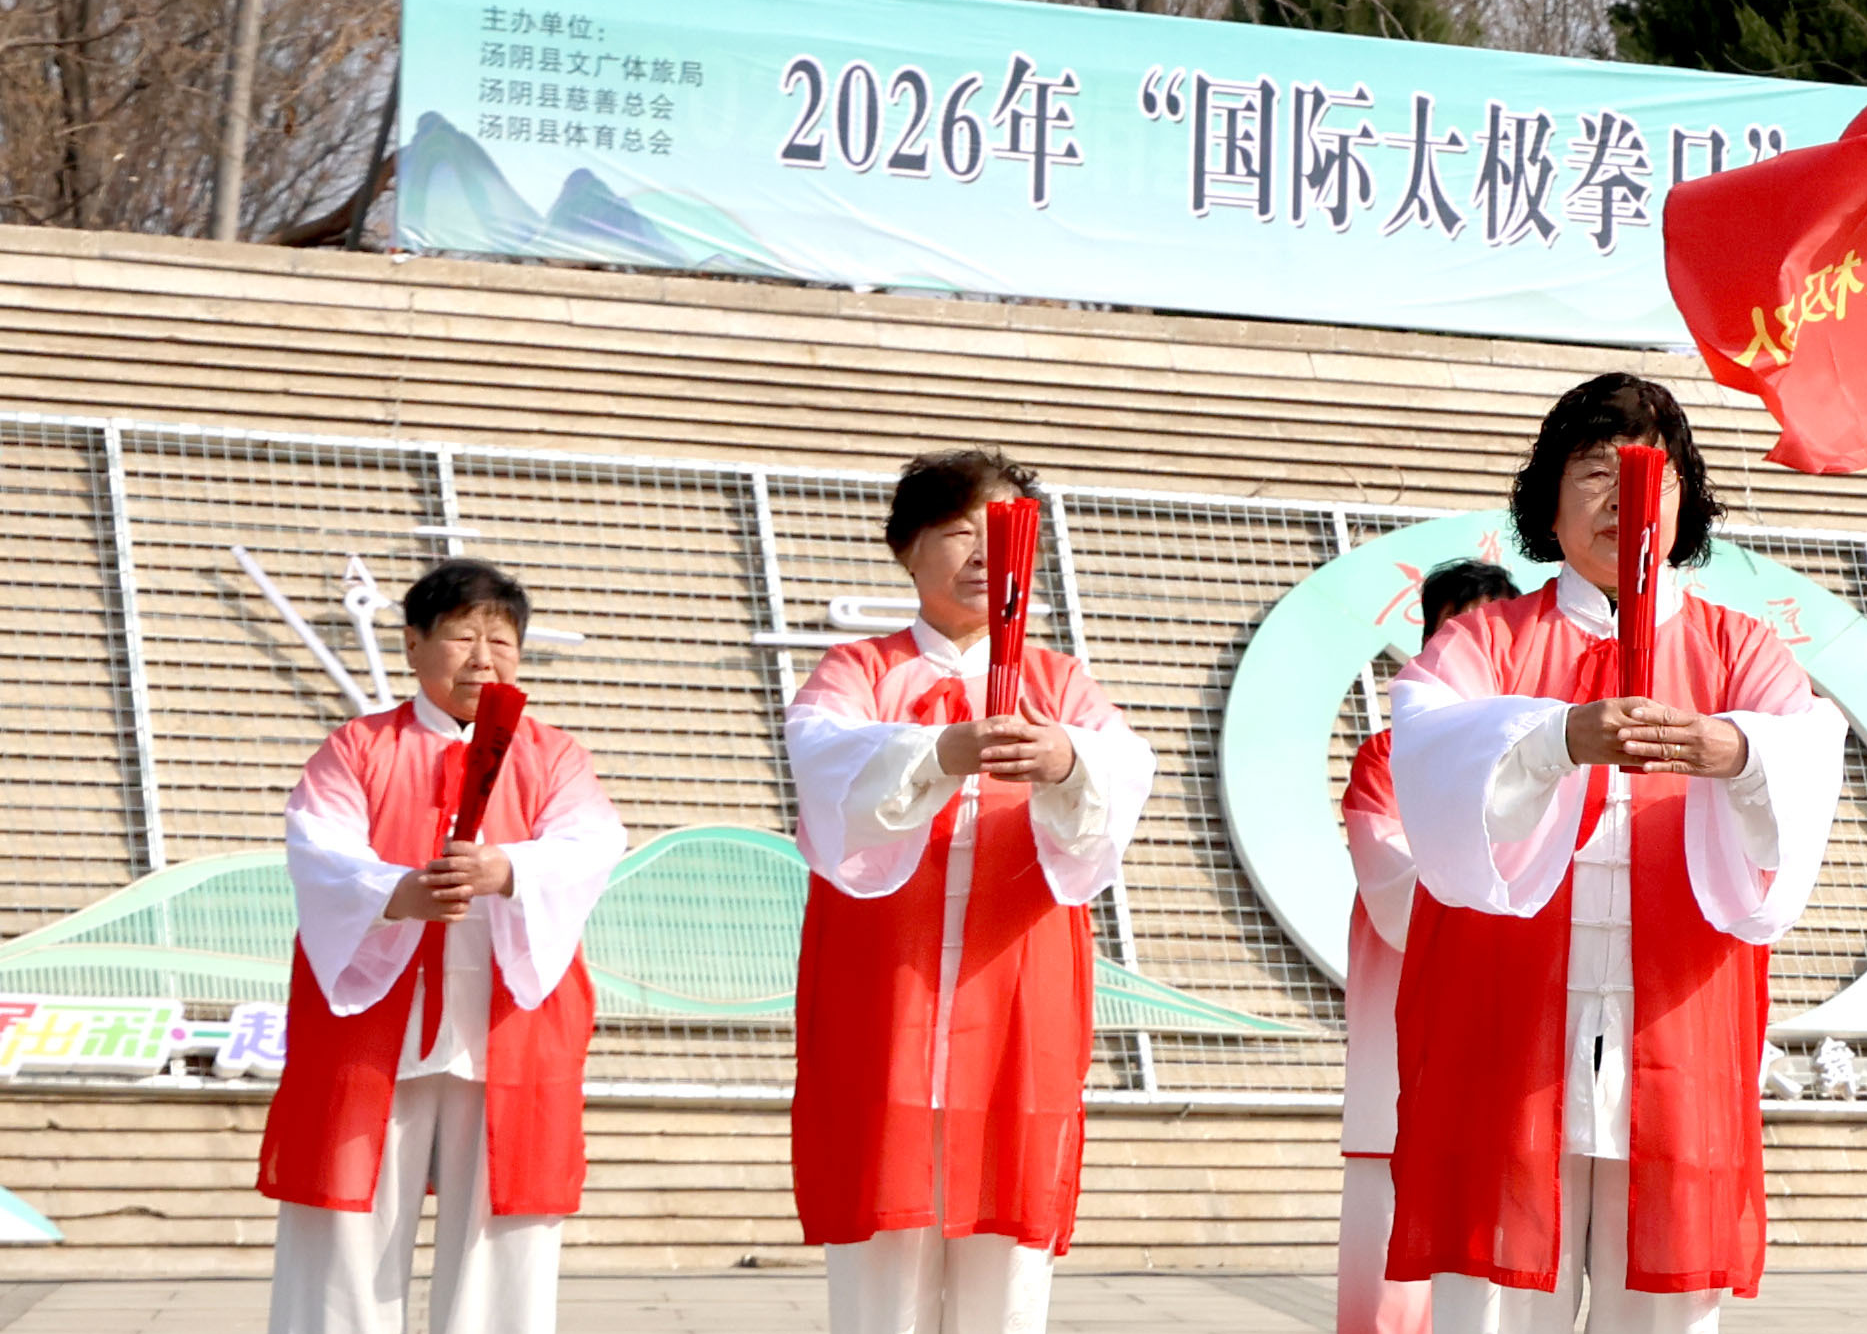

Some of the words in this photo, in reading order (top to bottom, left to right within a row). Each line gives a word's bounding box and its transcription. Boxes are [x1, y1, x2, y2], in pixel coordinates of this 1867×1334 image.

[481, 4, 606, 42] 主办单位：
[479, 41, 704, 88] 汤阴县文广体旅局
[478, 76, 675, 121] 汤阴县慈善总会
[476, 112, 673, 156] 汤阴县体育总会
